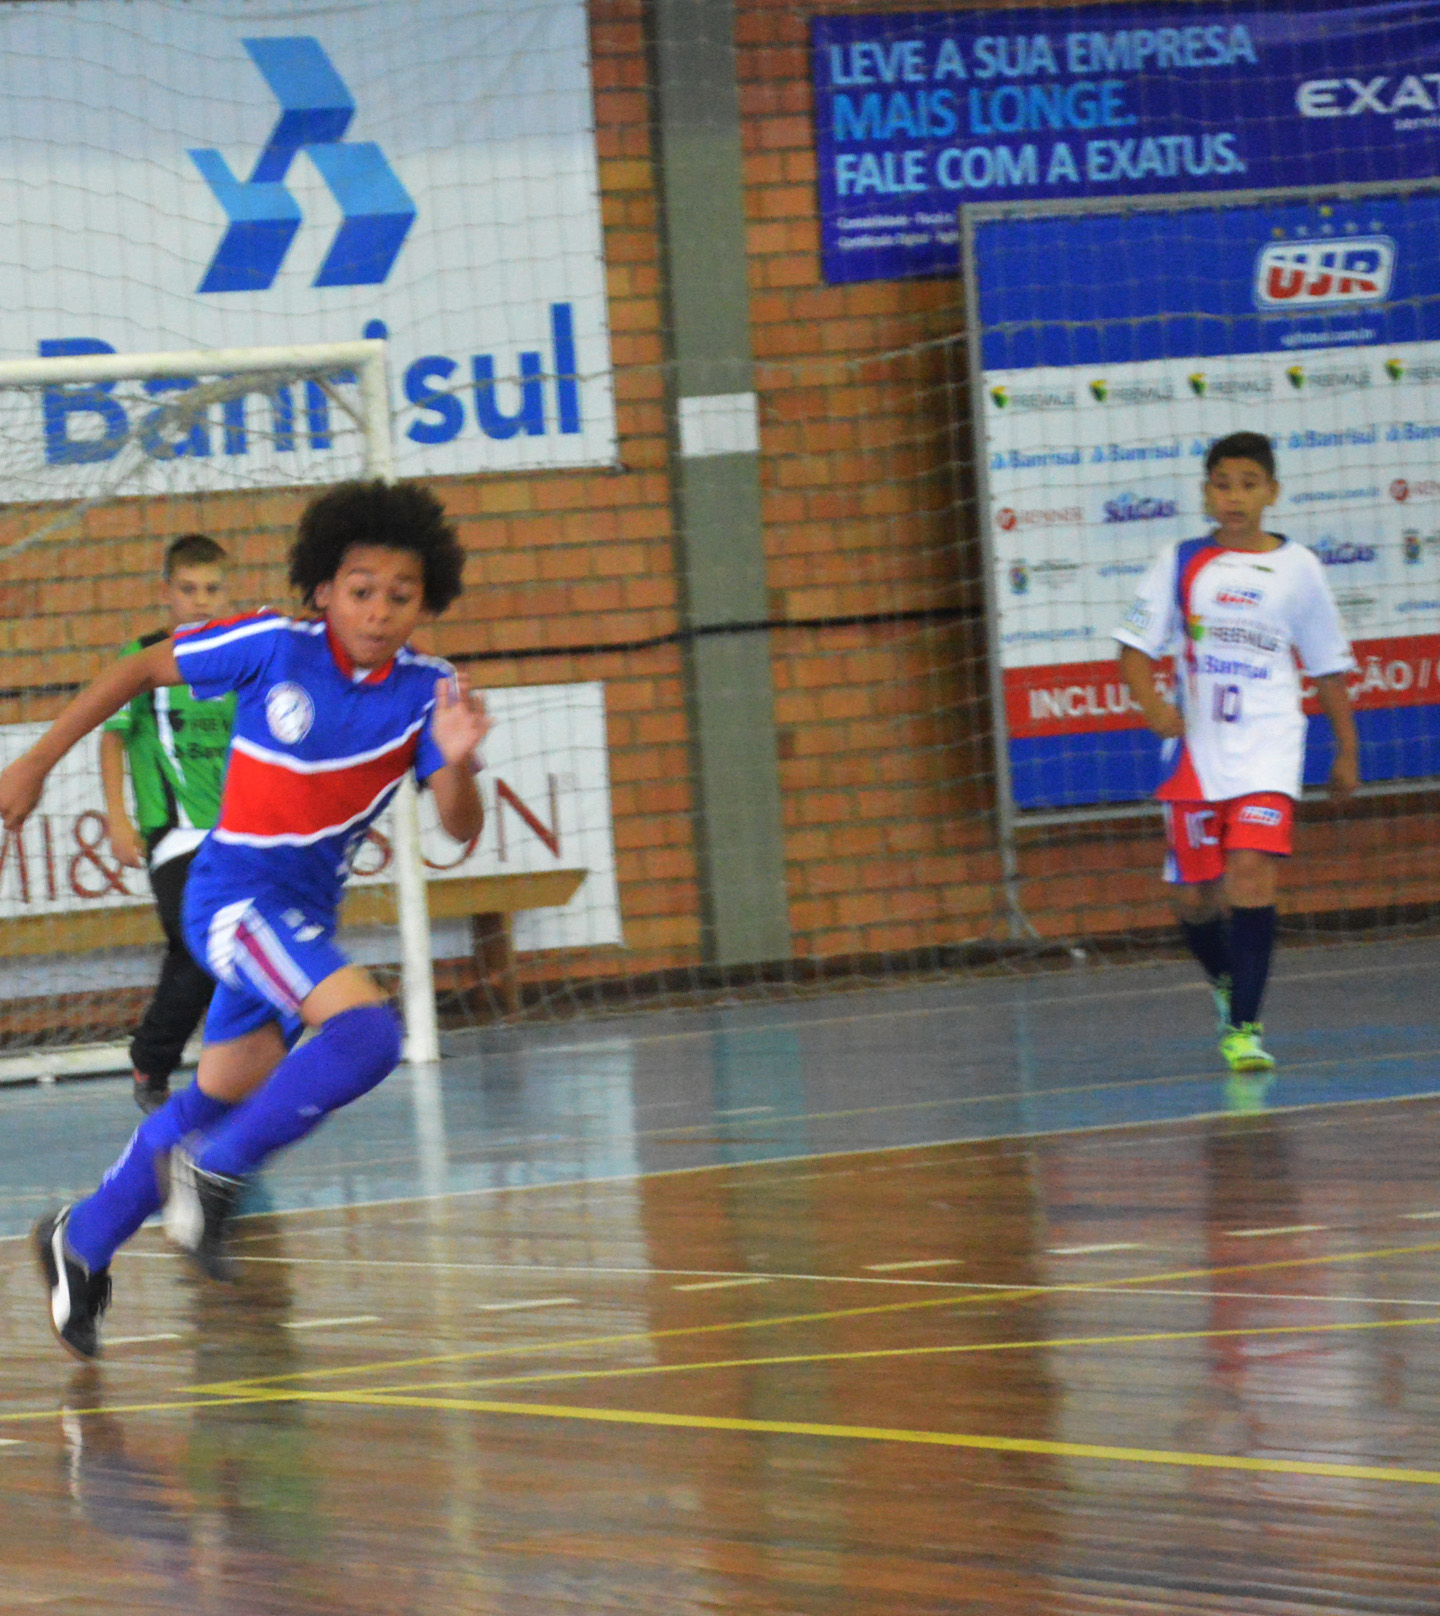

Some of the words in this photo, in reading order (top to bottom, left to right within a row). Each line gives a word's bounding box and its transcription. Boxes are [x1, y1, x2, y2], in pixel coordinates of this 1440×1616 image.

[829, 40, 928, 85] LEVE
[934, 39, 967, 80] A
[973, 35, 1058, 78] SUA
[1067, 24, 1257, 73] EMPRESA
[833, 87, 957, 141] MAIS
[969, 79, 1137, 136] LONGE.
[835, 149, 928, 195] FALE
[937, 142, 1037, 188] COM
[1045, 141, 1081, 184] A
[1086, 133, 1247, 182] EXATUS.
[1267, 249, 1380, 299] UJR
[38, 303, 582, 466] Banrsul
[1029, 672, 1175, 719] INCLU
